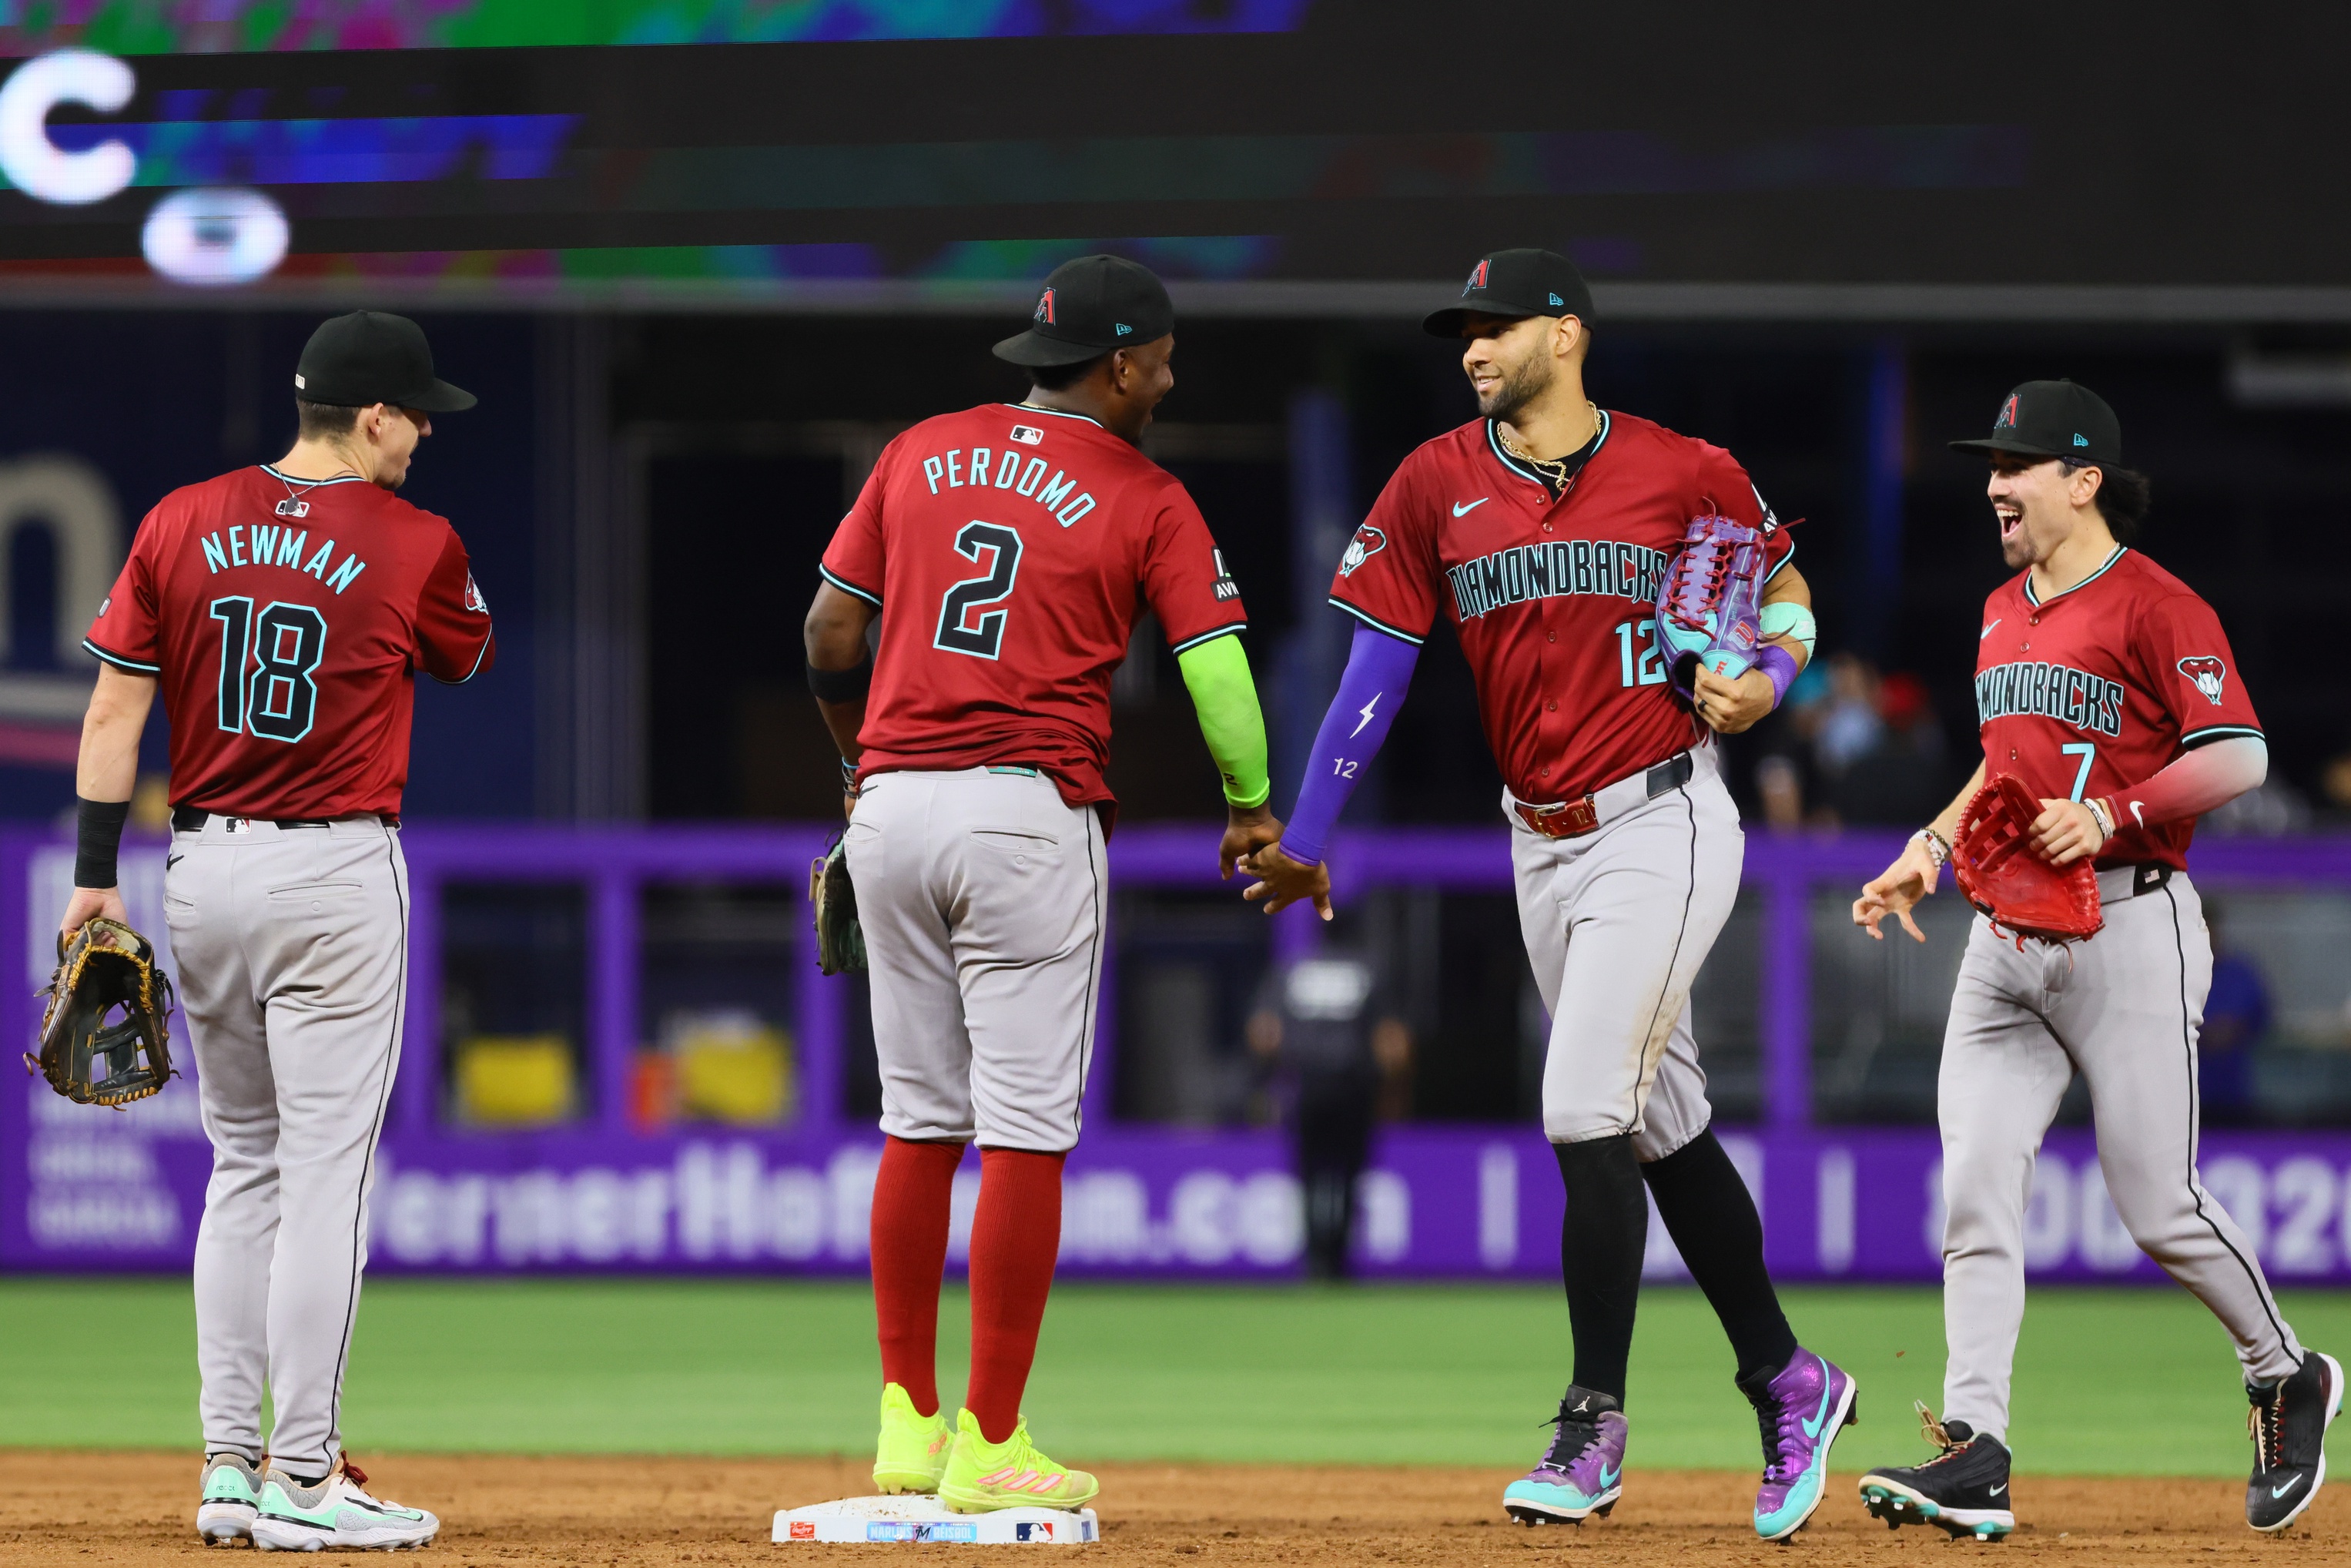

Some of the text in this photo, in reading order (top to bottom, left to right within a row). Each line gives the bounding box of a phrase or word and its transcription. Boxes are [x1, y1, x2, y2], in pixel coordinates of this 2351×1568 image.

[923, 447, 1097, 529] PERDOMO
[200, 524, 367, 595] NEWMAN
[933, 518, 1024, 662] 2
[1445, 540, 1669, 622] DIAMONDBACKS
[209, 595, 327, 744] 18
[1614, 618, 1669, 688] 12
[1333, 757, 1358, 779] 12
[2061, 742, 2095, 804] 7
[870, 1526, 913, 1540] MARLINS
